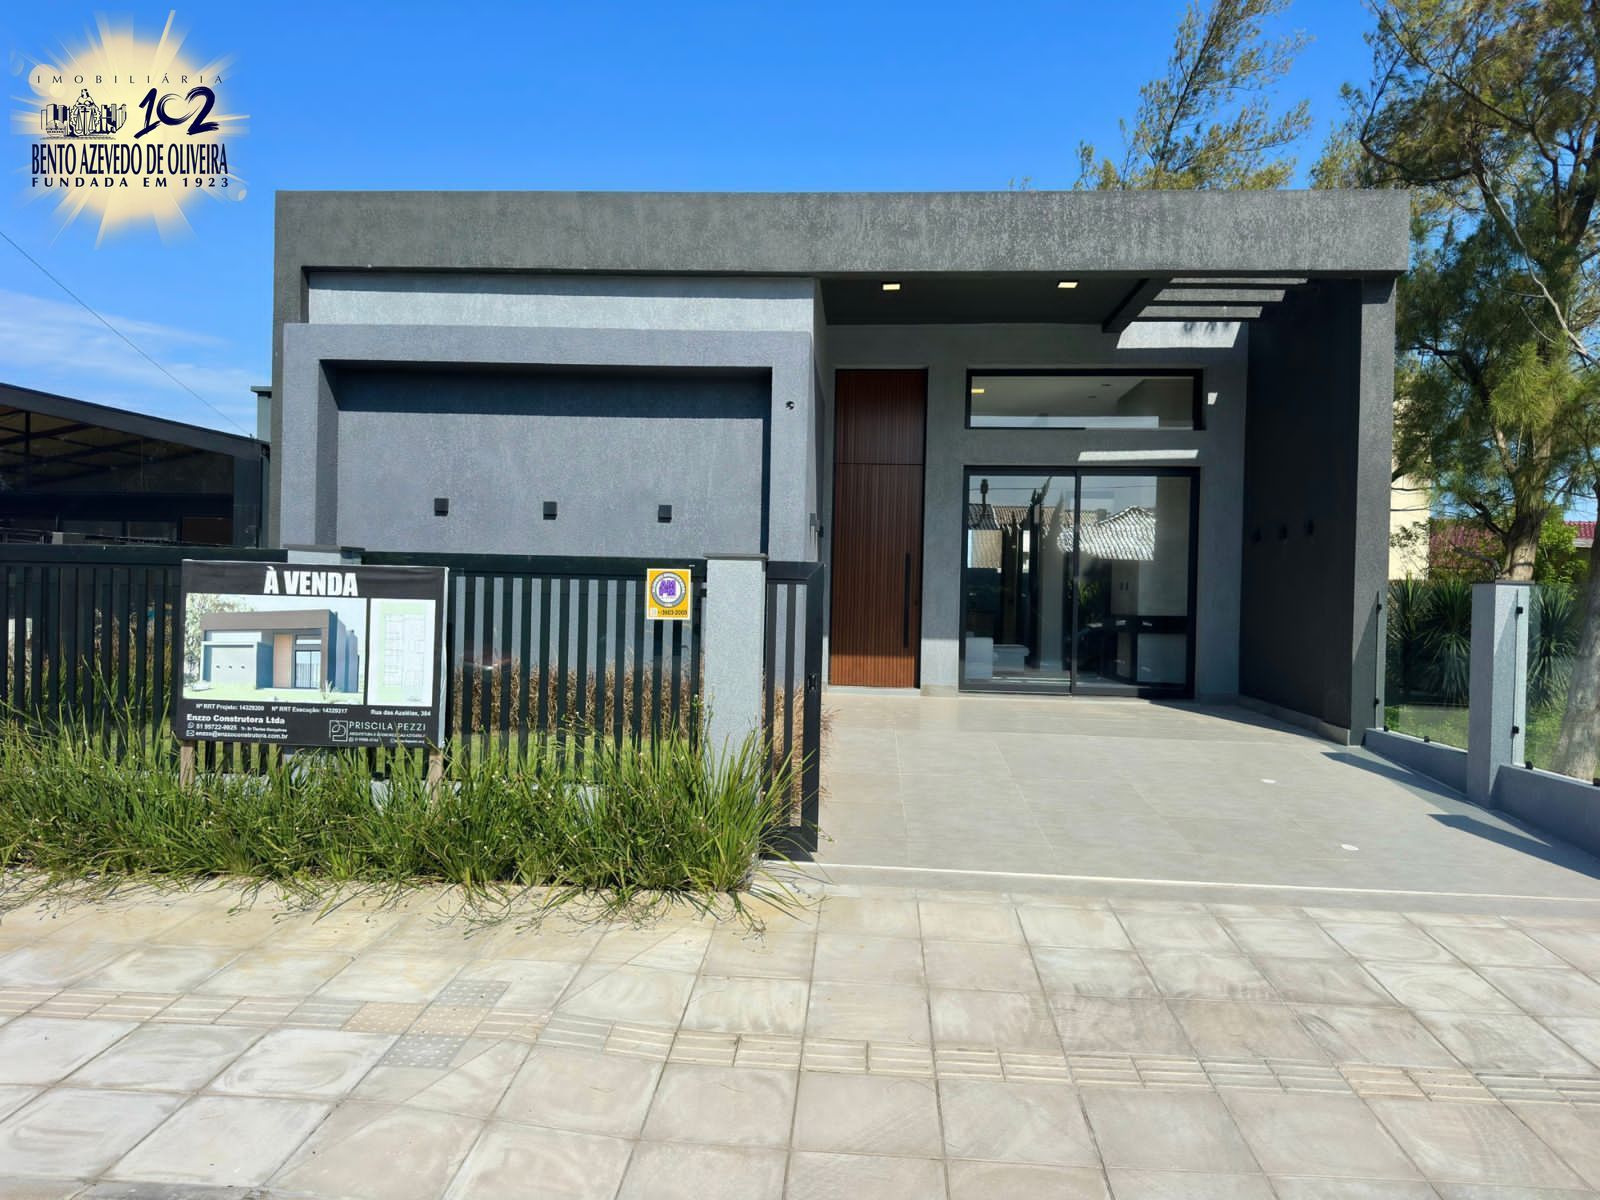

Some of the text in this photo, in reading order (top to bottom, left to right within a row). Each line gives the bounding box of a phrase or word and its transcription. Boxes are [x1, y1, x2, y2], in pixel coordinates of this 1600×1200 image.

[263, 565, 359, 597] À VENDA
[213, 714, 264, 724] Construtora
[266, 716, 285, 724] Ltda
[349, 720, 426, 731] PRISCILA PEZZI
